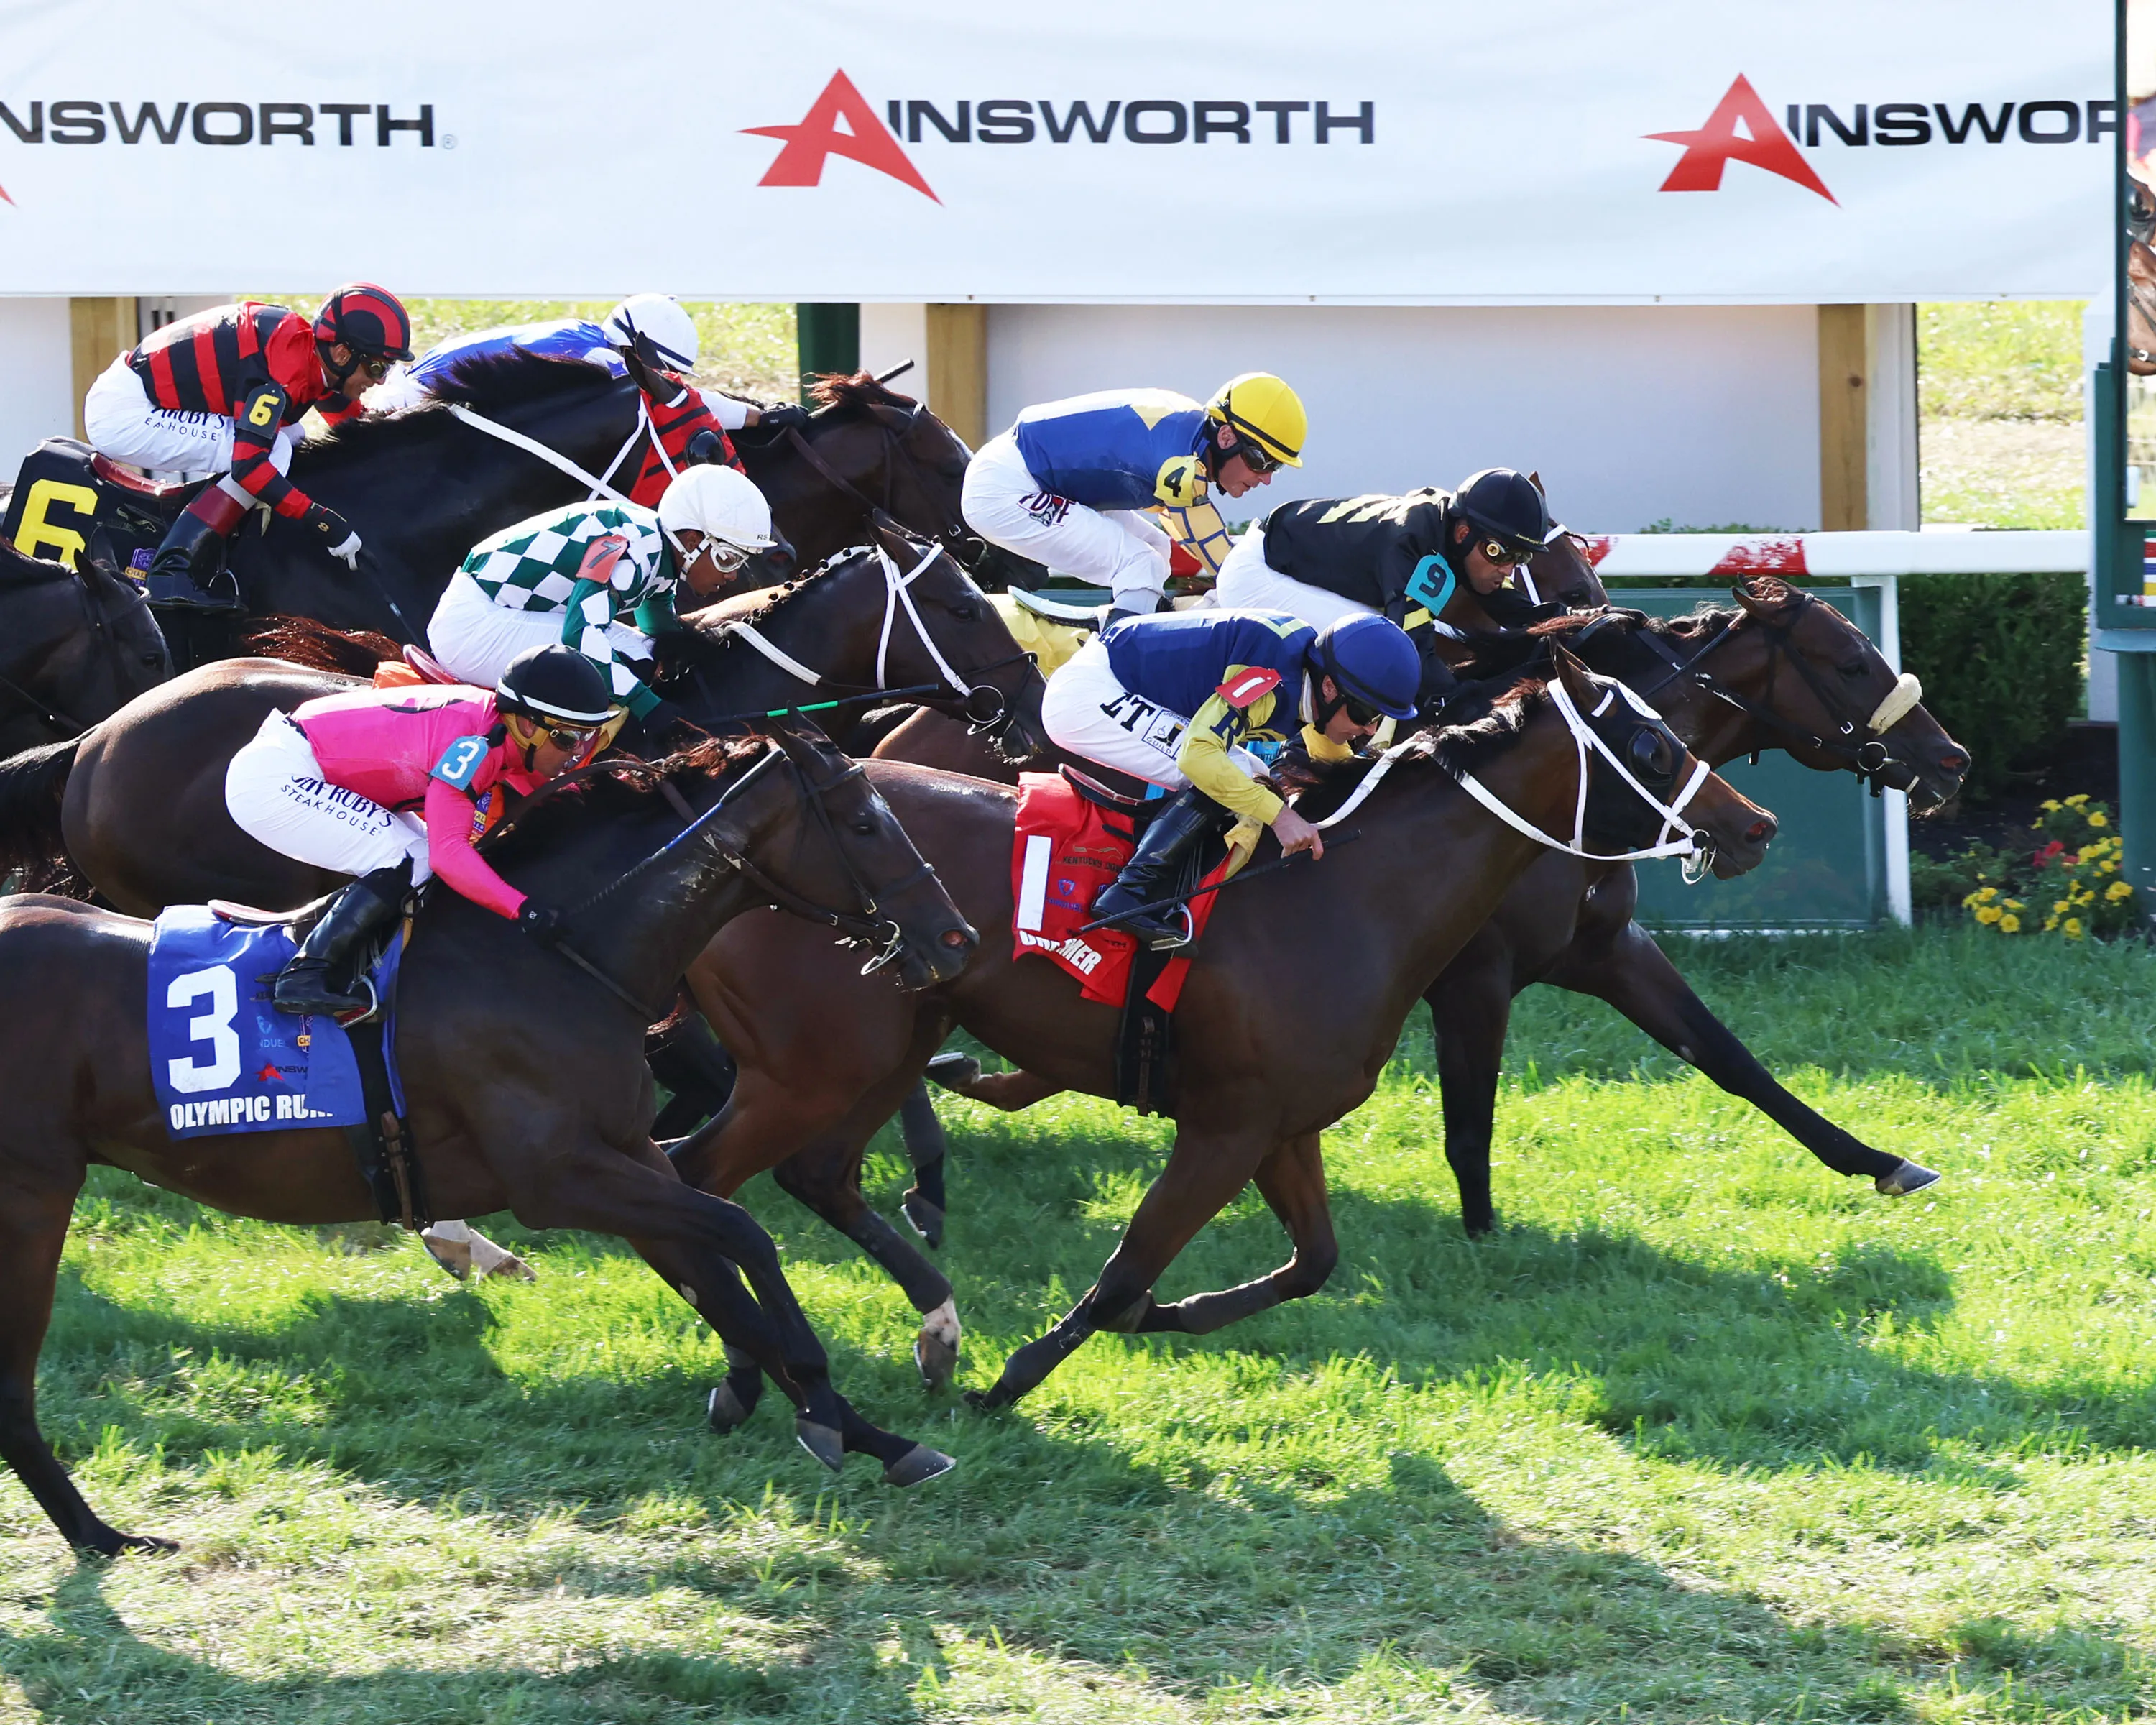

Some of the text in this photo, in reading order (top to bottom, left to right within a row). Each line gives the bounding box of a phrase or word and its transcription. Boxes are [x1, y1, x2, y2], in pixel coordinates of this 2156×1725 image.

[0, 101, 435, 147] NSWORTH
[735, 67, 1376, 206] AINSWORTH
[249, 393, 280, 426] 6
[1164, 466, 1187, 498] 4
[14, 479, 98, 570] 6
[586, 540, 621, 569] 7
[1419, 563, 1447, 598] 9
[442, 741, 479, 779] 3
[1146, 737, 1171, 754] GUILD
[281, 784, 378, 836] STEAKHOUSE
[328, 784, 396, 827] RUBY'S
[1017, 835, 1051, 931] 1
[167, 964, 241, 1094] 3
[170, 1095, 271, 1131] OLYMPIC
